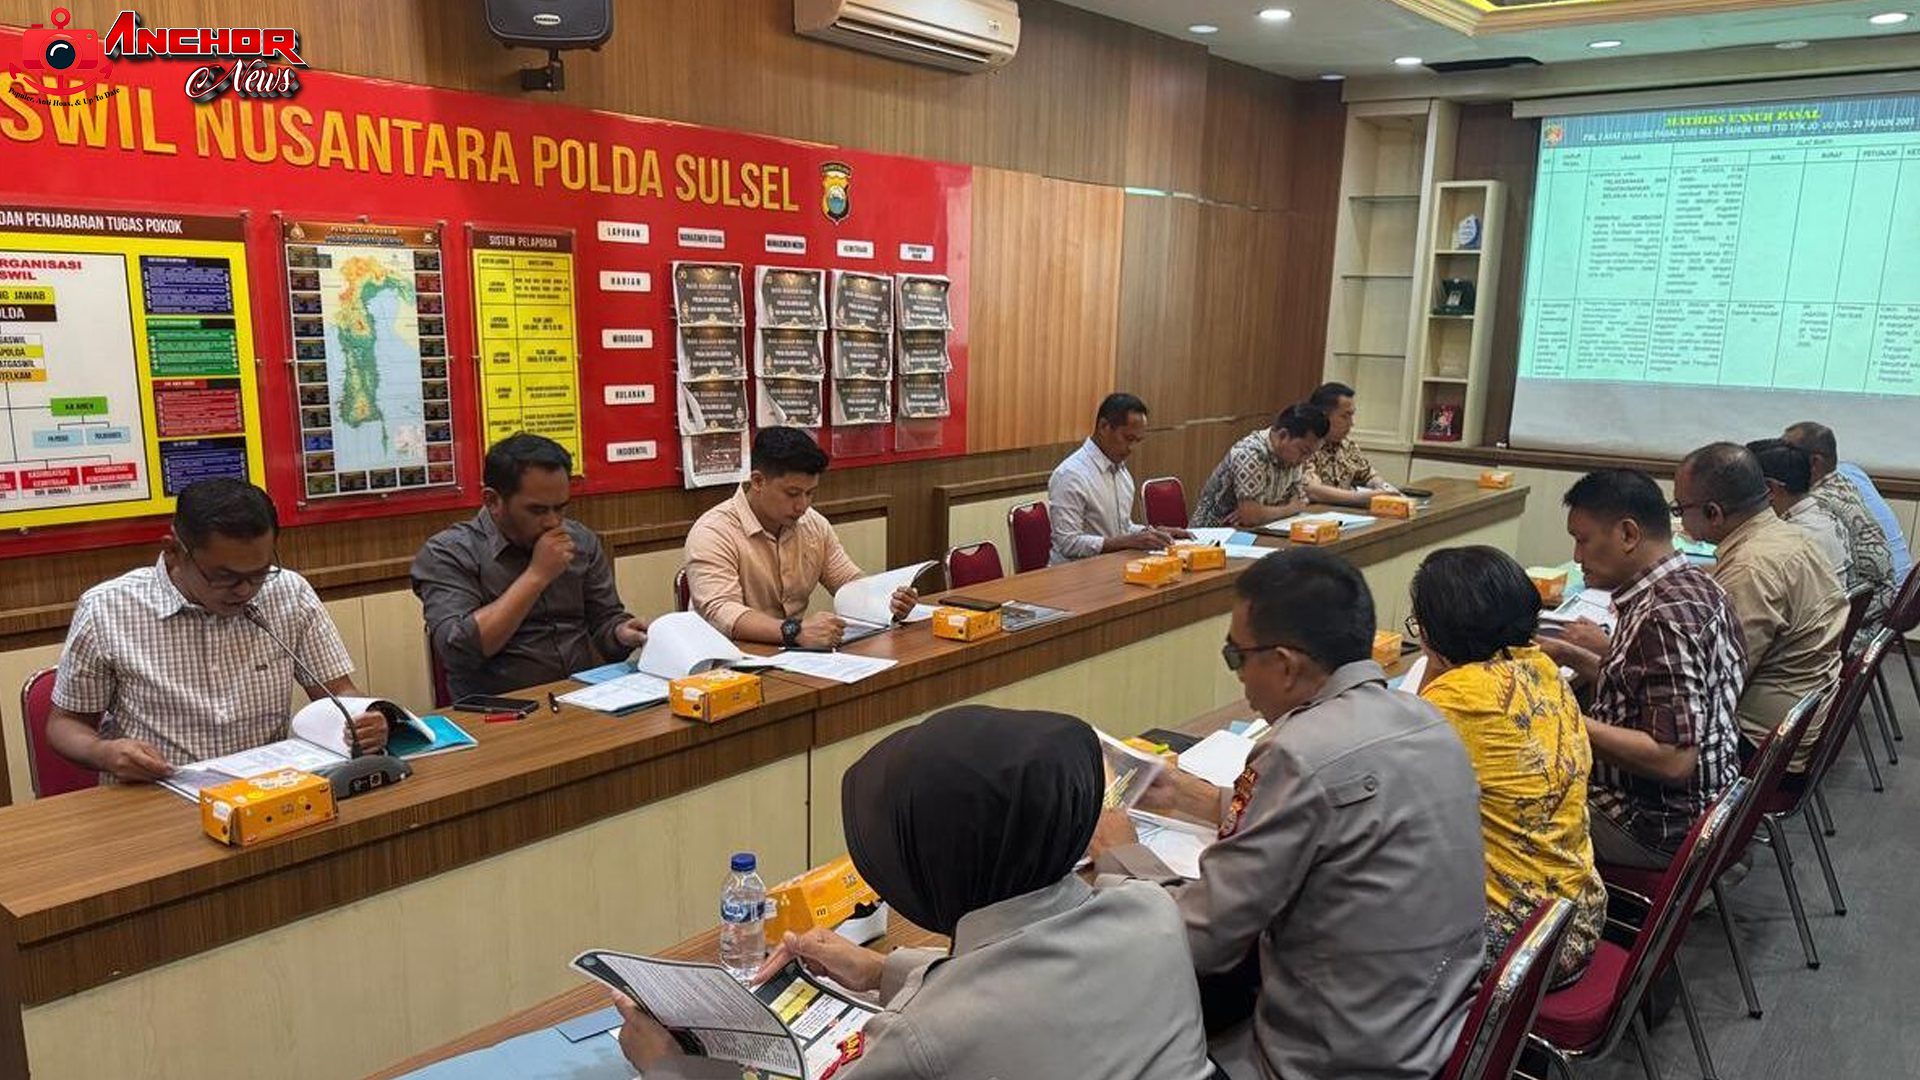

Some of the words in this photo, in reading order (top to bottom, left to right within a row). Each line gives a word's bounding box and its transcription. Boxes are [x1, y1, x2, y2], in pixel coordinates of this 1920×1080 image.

[195, 98, 520, 184] NUSANTARA
[532, 135, 664, 198] POLDA
[675, 154, 800, 212] SULSEL
[26, 212, 104, 230] PENJABARAN
[106, 216, 144, 232] TUGAS
[145, 217, 183, 234] POKOK
[607, 226, 641, 238] LAPORAN
[489, 235, 516, 247] SISTEM
[518, 236, 558, 249] PELAPORAN
[611, 277, 642, 286] HARIAN
[14, 291, 46, 300] JAWAB
[0, 306, 26, 319] LDA
[612, 333, 644, 343] MINGGUAN
[615, 390, 646, 400] BULANAN
